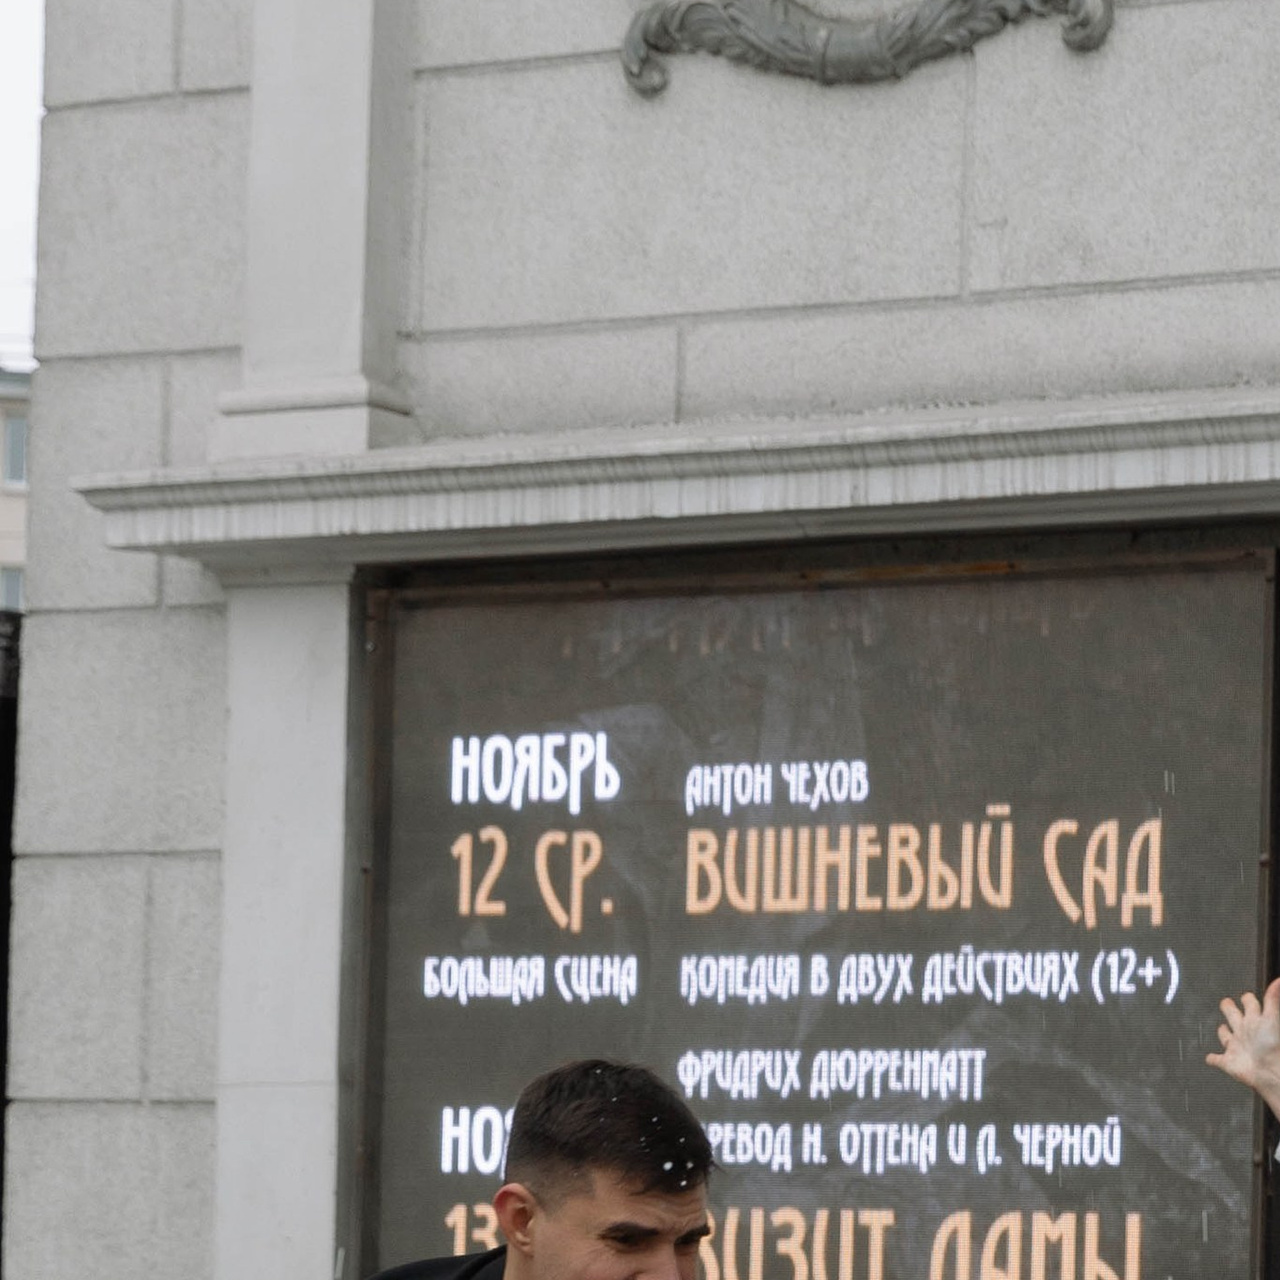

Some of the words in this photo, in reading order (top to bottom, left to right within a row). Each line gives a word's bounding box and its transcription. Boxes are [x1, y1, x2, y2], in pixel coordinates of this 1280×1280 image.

[451, 731, 621, 815] НОЯБРЬ
[685, 764, 772, 816] АНТОН
[781, 759, 870, 811] ЧЕХОВ
[450, 825, 508, 916] 12
[534, 829, 614, 935] СР.
[685, 803, 1014, 915] ВИШНЕВЫЙ
[1043, 817, 1164, 930] САД
[423, 955, 546, 1006] БОЛЬШАЯ
[554, 954, 638, 1006] СЦЕНА
[680, 954, 800, 1005] КОМЕДИЯ
[810, 954, 830, 997] В
[837, 953, 914, 1005] ДВУХ
[921, 944, 1080, 1005] ДЕЙСТВИЯХ
[1091, 947, 1181, 1006] (12+)
[677, 1049, 802, 1100] ФРИДРИХ
[810, 1049, 987, 1101] ДЮРРЕНМАТТ
[802, 1122, 828, 1165] Н.
[839, 1122, 938, 1174] ОТТЕНА
[947, 1123, 967, 1165] И
[976, 1122, 1003, 1175] Л.
[1013, 1116, 1121, 1175] ЧЕРНОЙ
